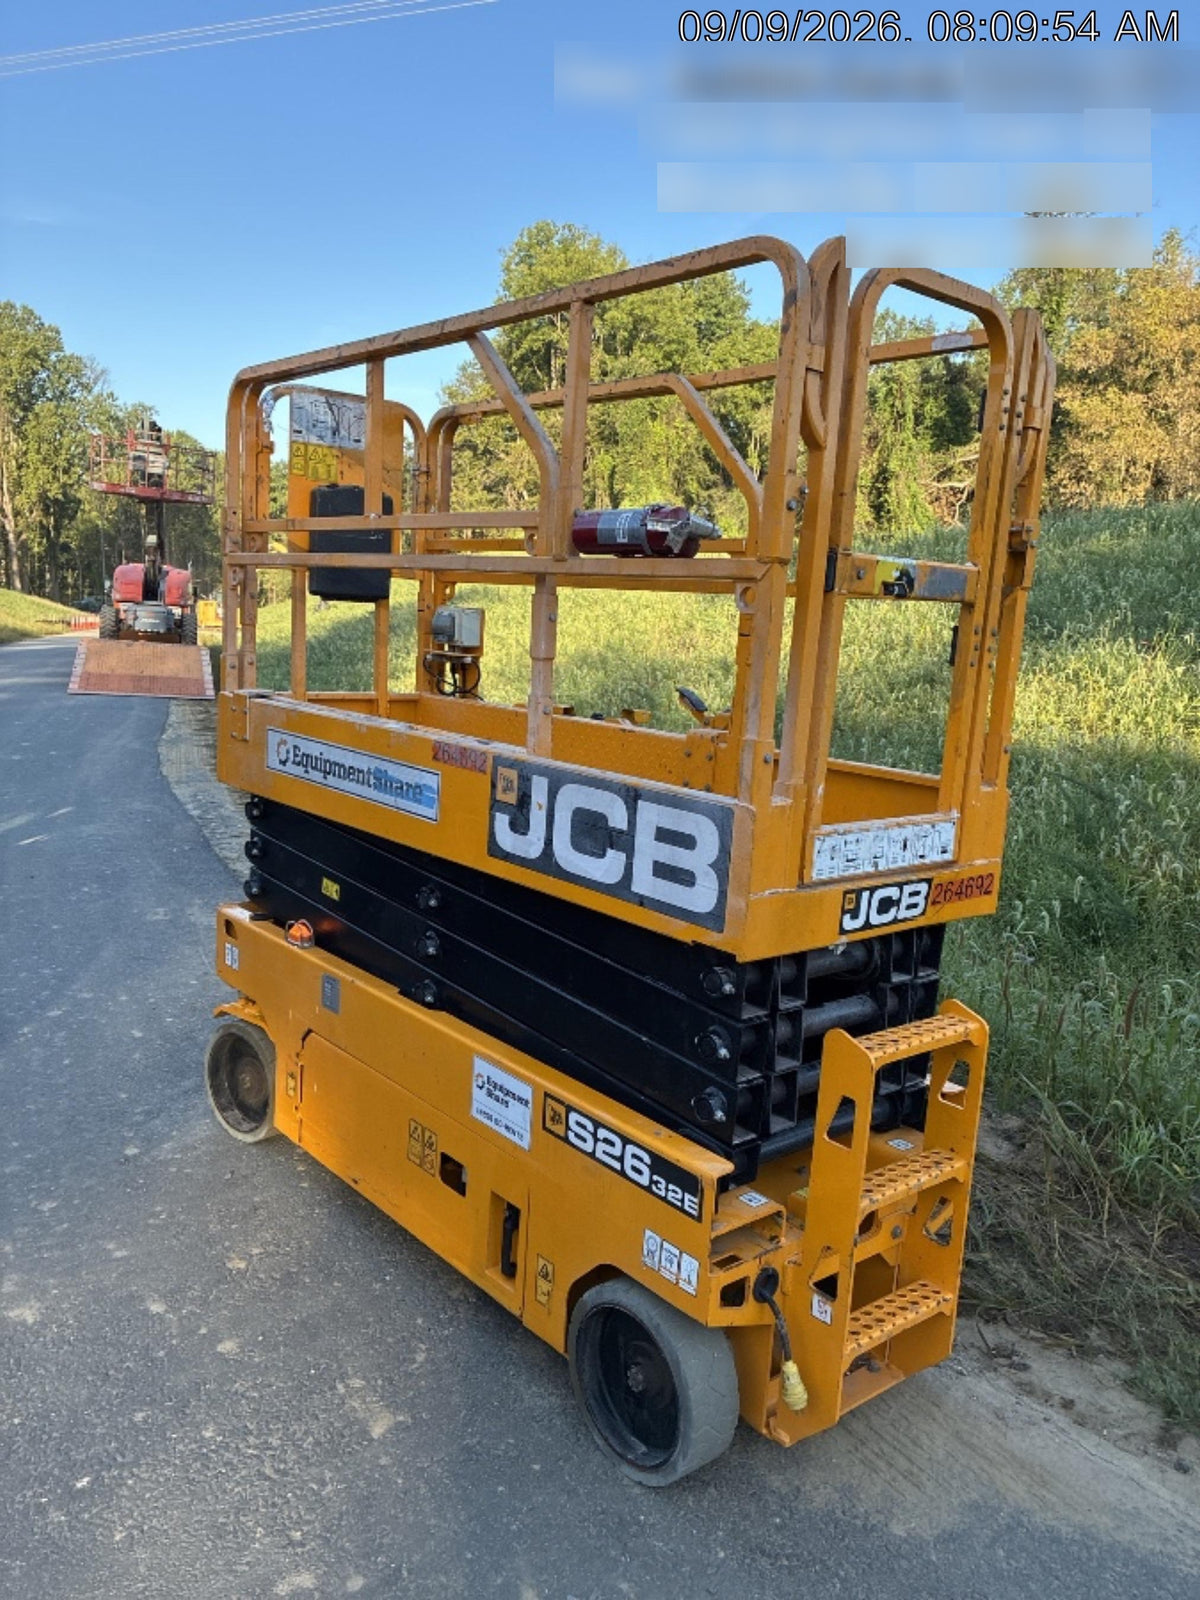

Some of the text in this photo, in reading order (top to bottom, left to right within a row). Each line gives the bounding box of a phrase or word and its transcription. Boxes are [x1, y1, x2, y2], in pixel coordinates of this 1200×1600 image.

[291, 744, 423, 799] EquipmentShare
[432, 741, 487, 775] 264692
[494, 775, 720, 913] JCB
[842, 881, 930, 931] JCB
[931, 873, 995, 906] 264692
